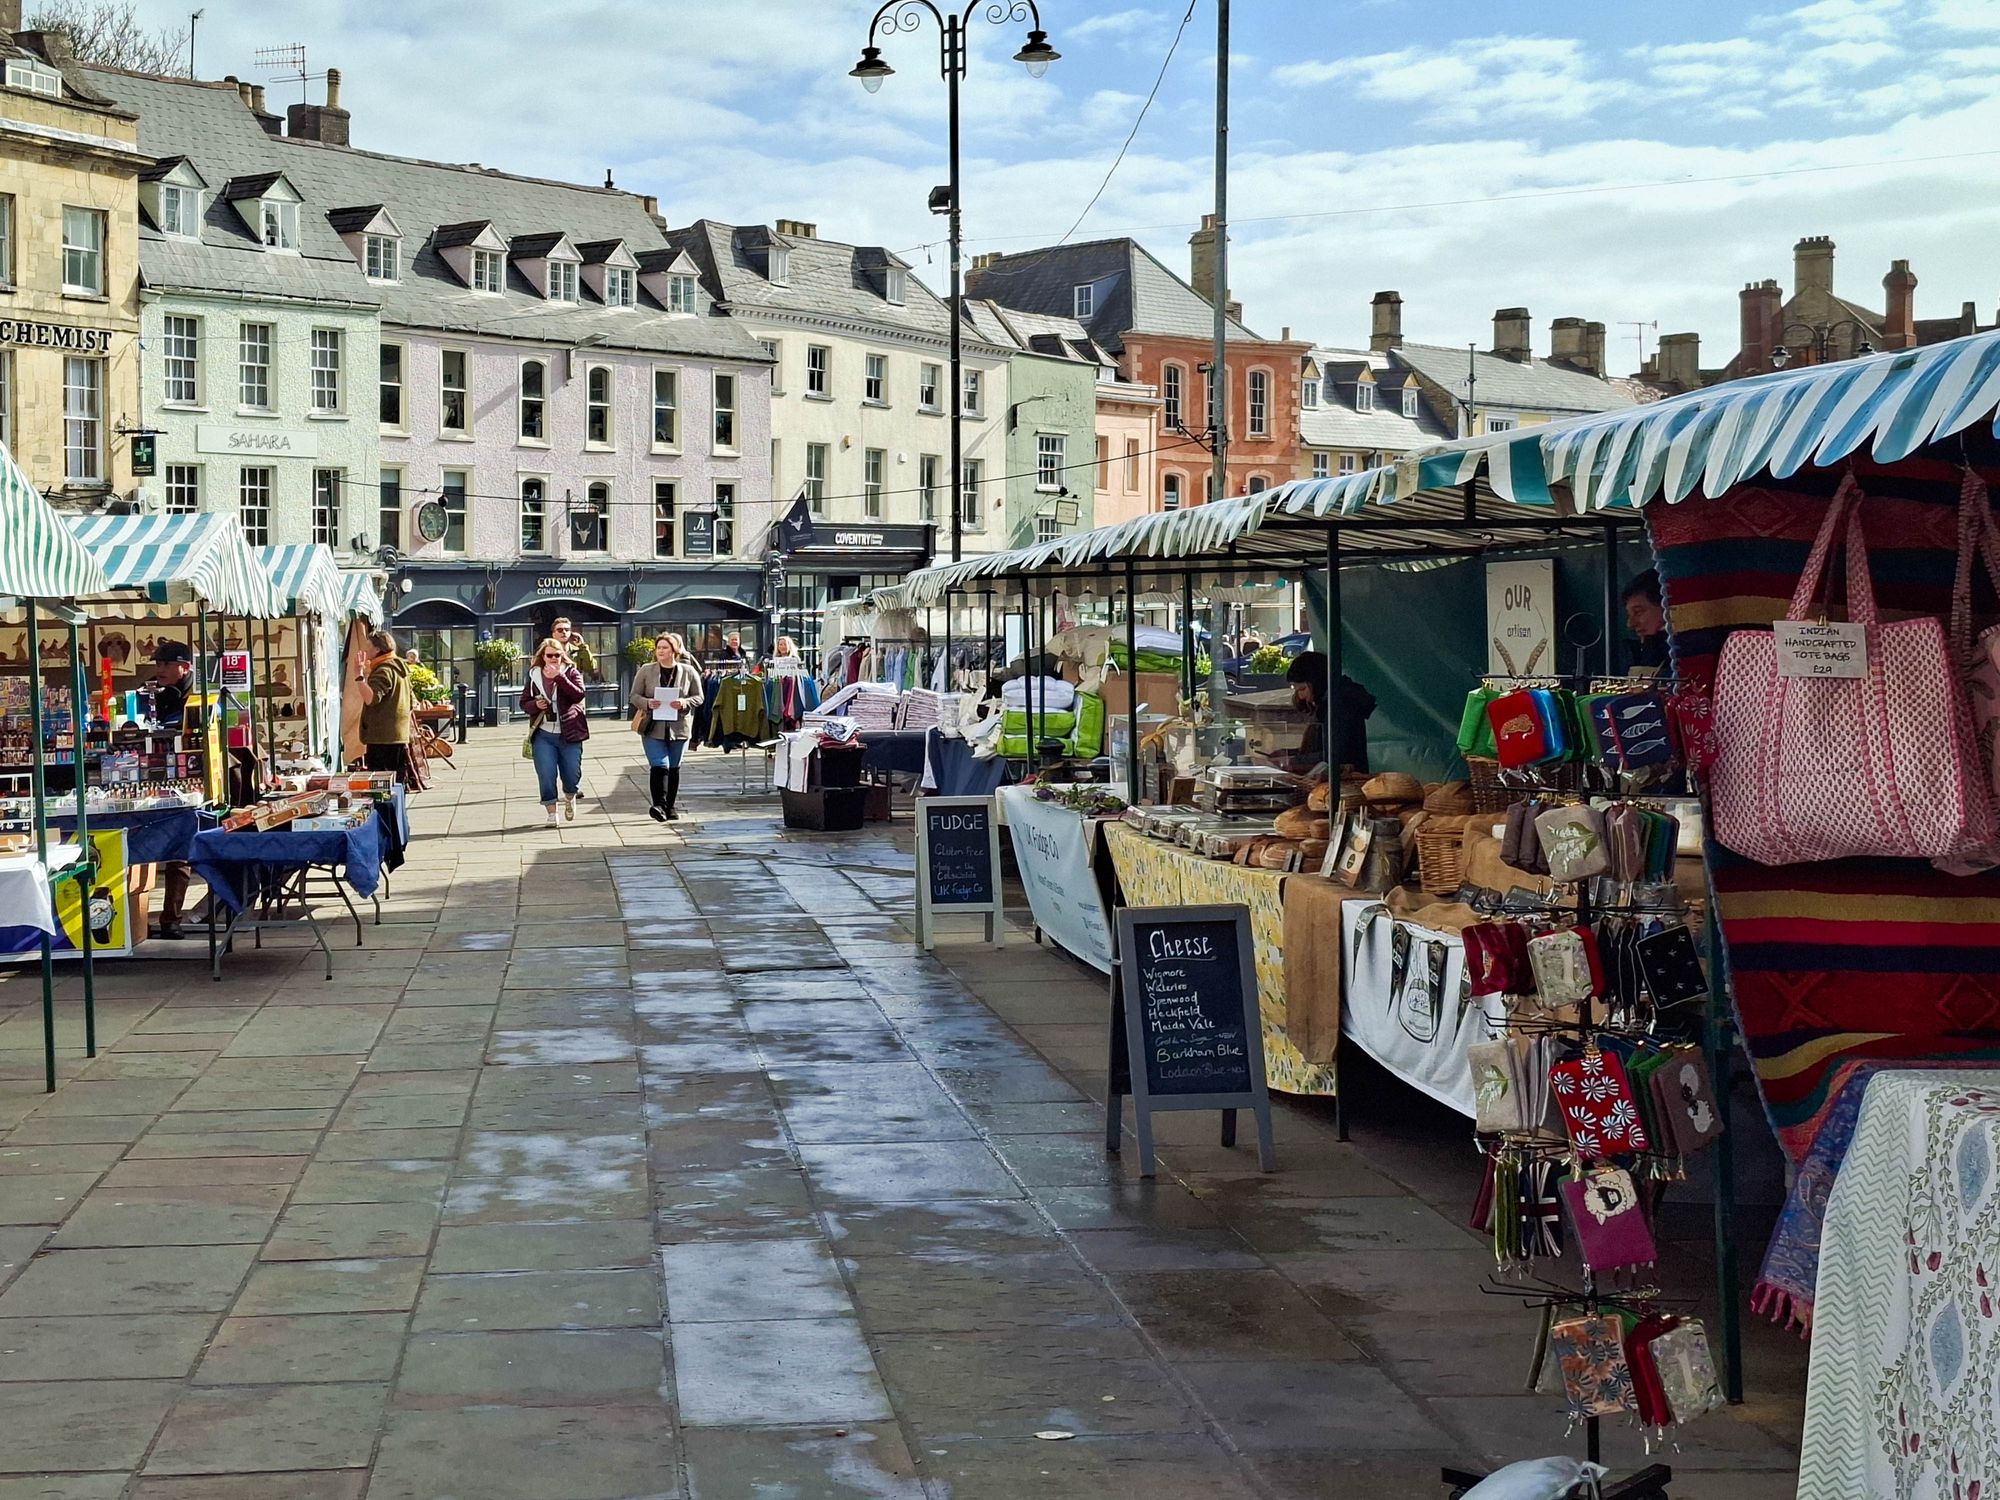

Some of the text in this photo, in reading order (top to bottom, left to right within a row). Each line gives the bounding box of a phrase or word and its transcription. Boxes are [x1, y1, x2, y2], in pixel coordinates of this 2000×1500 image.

[0, 321, 112, 351] CHEMIST
[229, 433, 291, 450] SAHARA
[835, 532, 871, 546] COVENTRY
[537, 577, 587, 588] COTSWOLD
[1505, 584, 1531, 611] OUR
[1507, 623, 1531, 638] artisan
[1799, 627, 1840, 635] INDIAN
[1785, 638, 1856, 648] HANDCRAFTED
[1792, 651, 1850, 661] TOTE BAGS
[1813, 665, 1832, 674] £29
[930, 814, 984, 831] FUDGE
[1049, 833, 1060, 860] Co
[934, 883, 950, 896] UK
[973, 882, 984, 892] Co
[1150, 930, 1213, 958] Cheese
[1143, 968, 1186, 983] Wigmore
[1145, 982, 1188, 992] Waterloo
[1148, 992, 1198, 1010] Spenwood
[1148, 1005, 1205, 1020] Heckfield
[1152, 1018, 1215, 1033] Maida Vale
[1156, 1043, 1244, 1063] Barkham Blue
